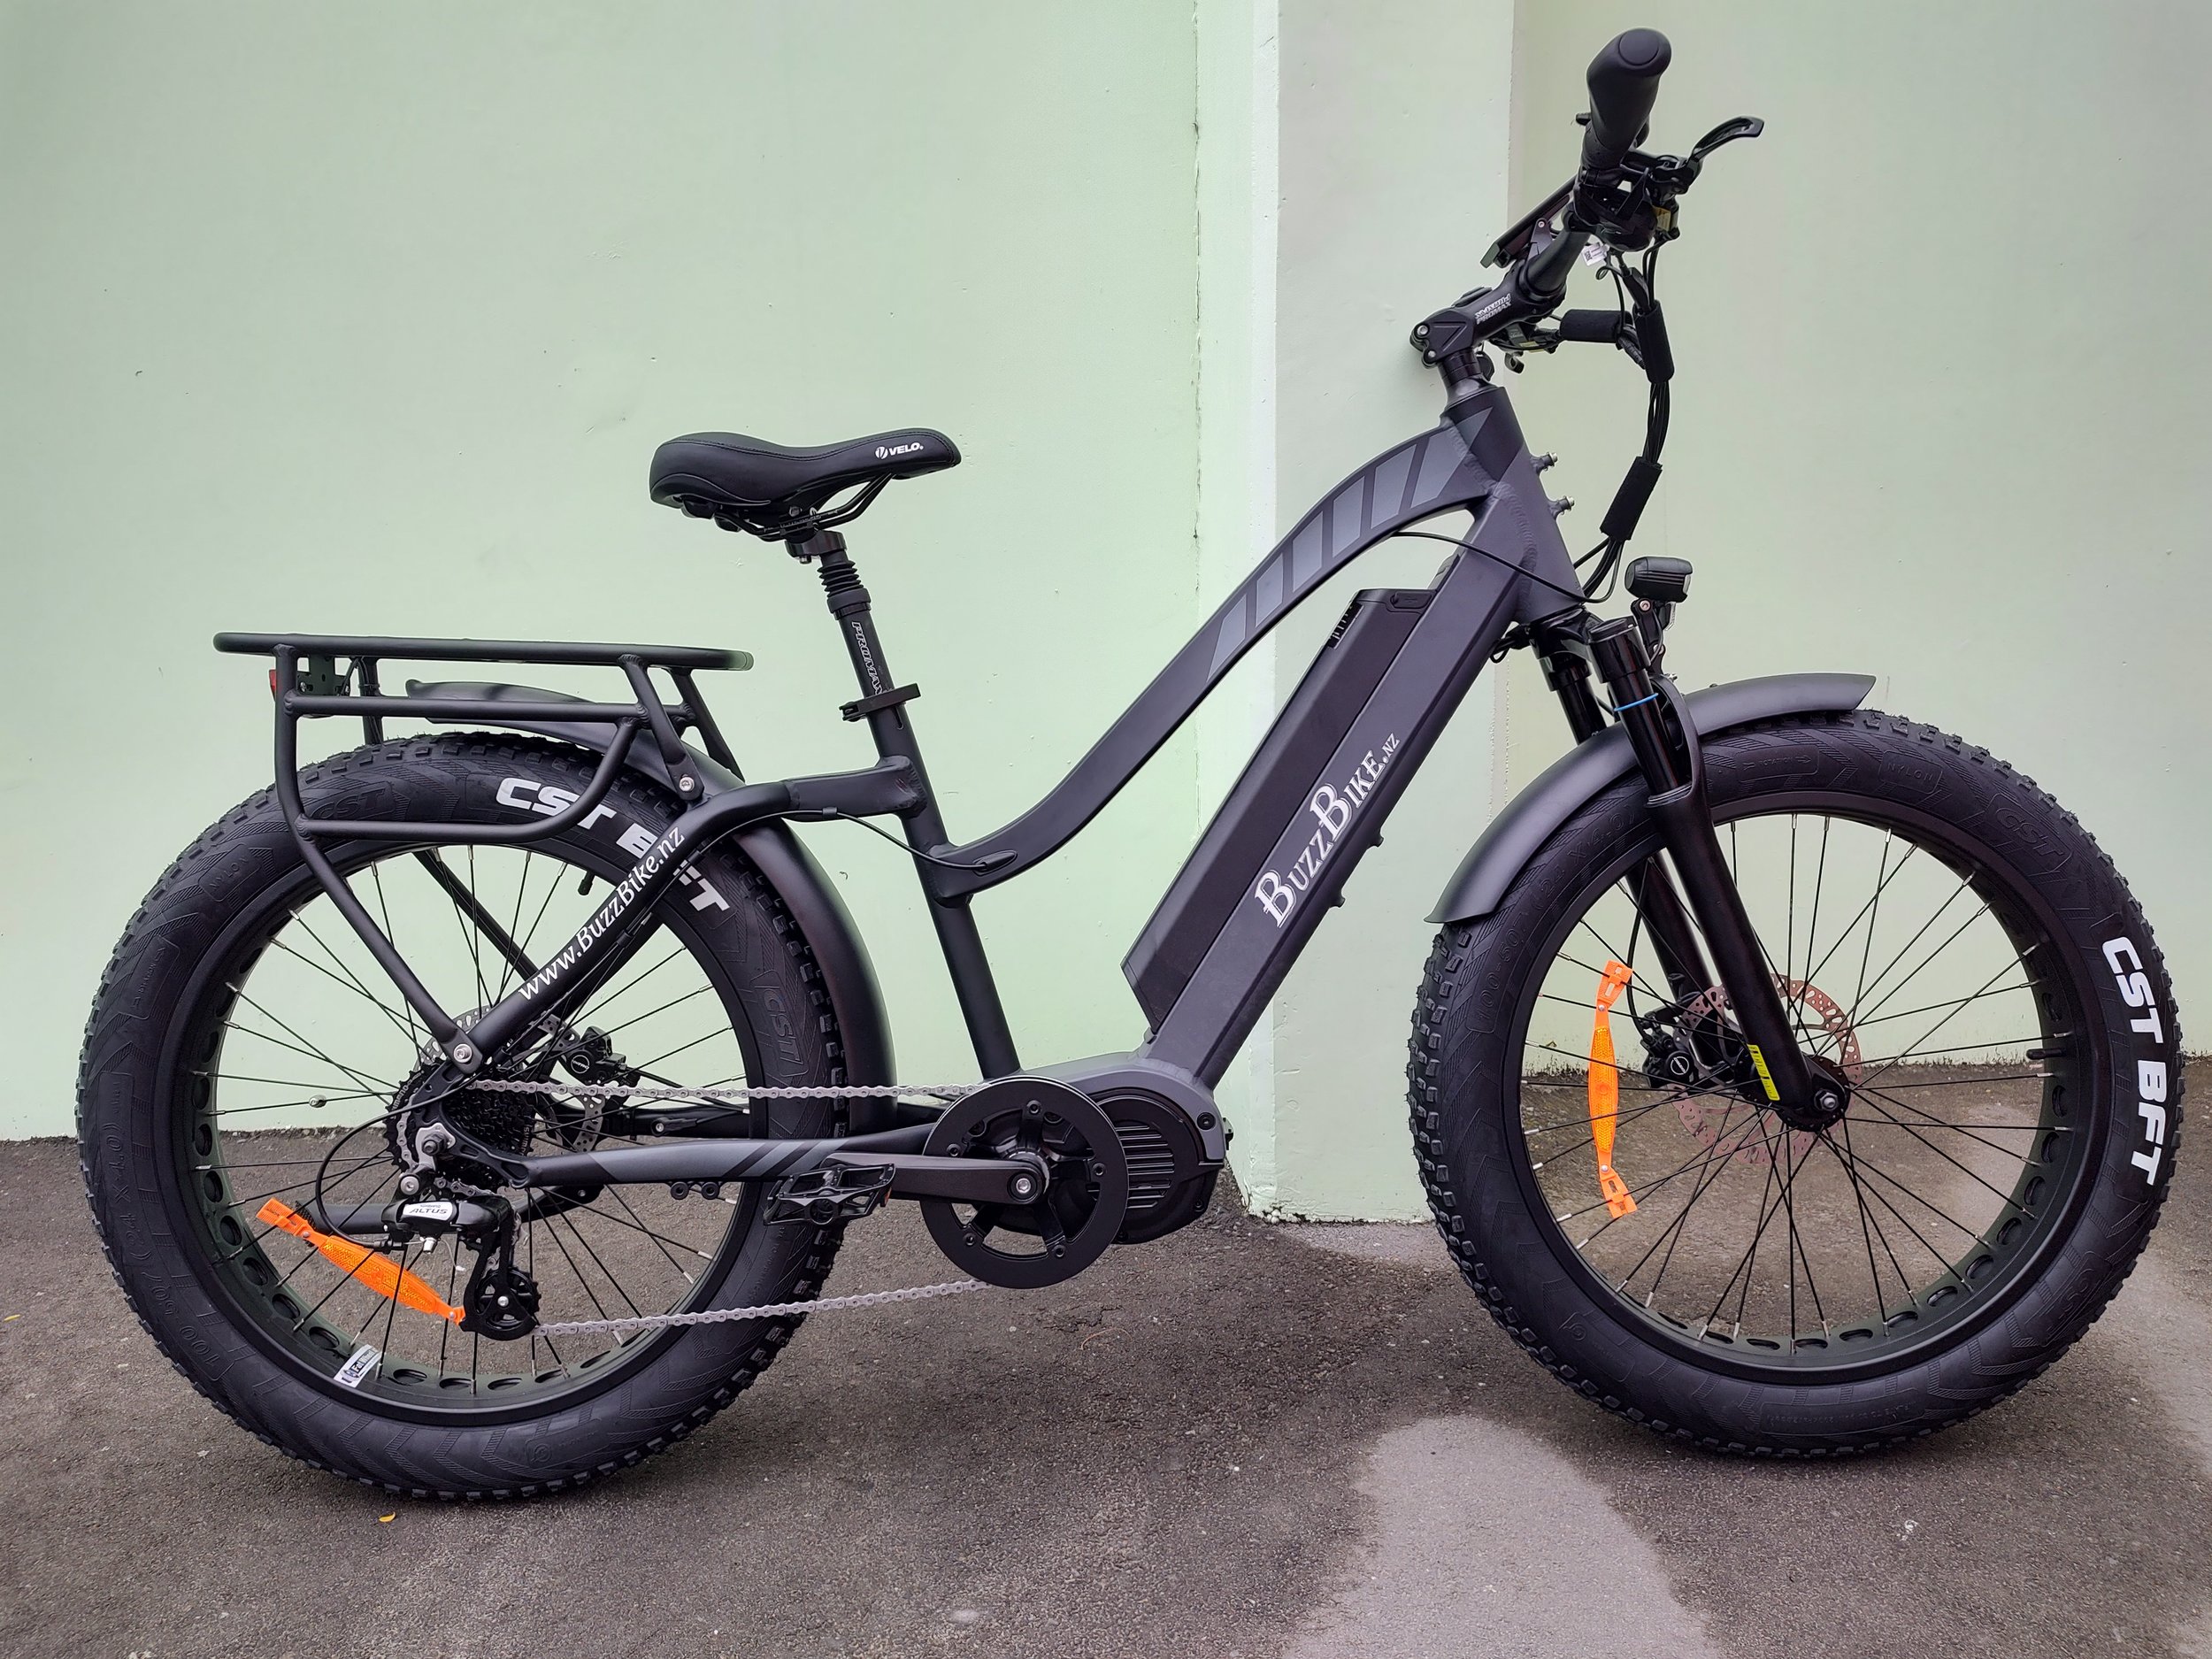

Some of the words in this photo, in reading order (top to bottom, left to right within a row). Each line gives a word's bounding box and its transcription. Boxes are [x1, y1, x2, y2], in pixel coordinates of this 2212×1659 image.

[889, 442, 920, 457] VELO
[495, 777, 618, 831] CST
[518, 826, 686, 1001] www.BuzzBike.nz
[2101, 936, 2163, 1044] CST
[2131, 1059, 2167, 1186] BFT
